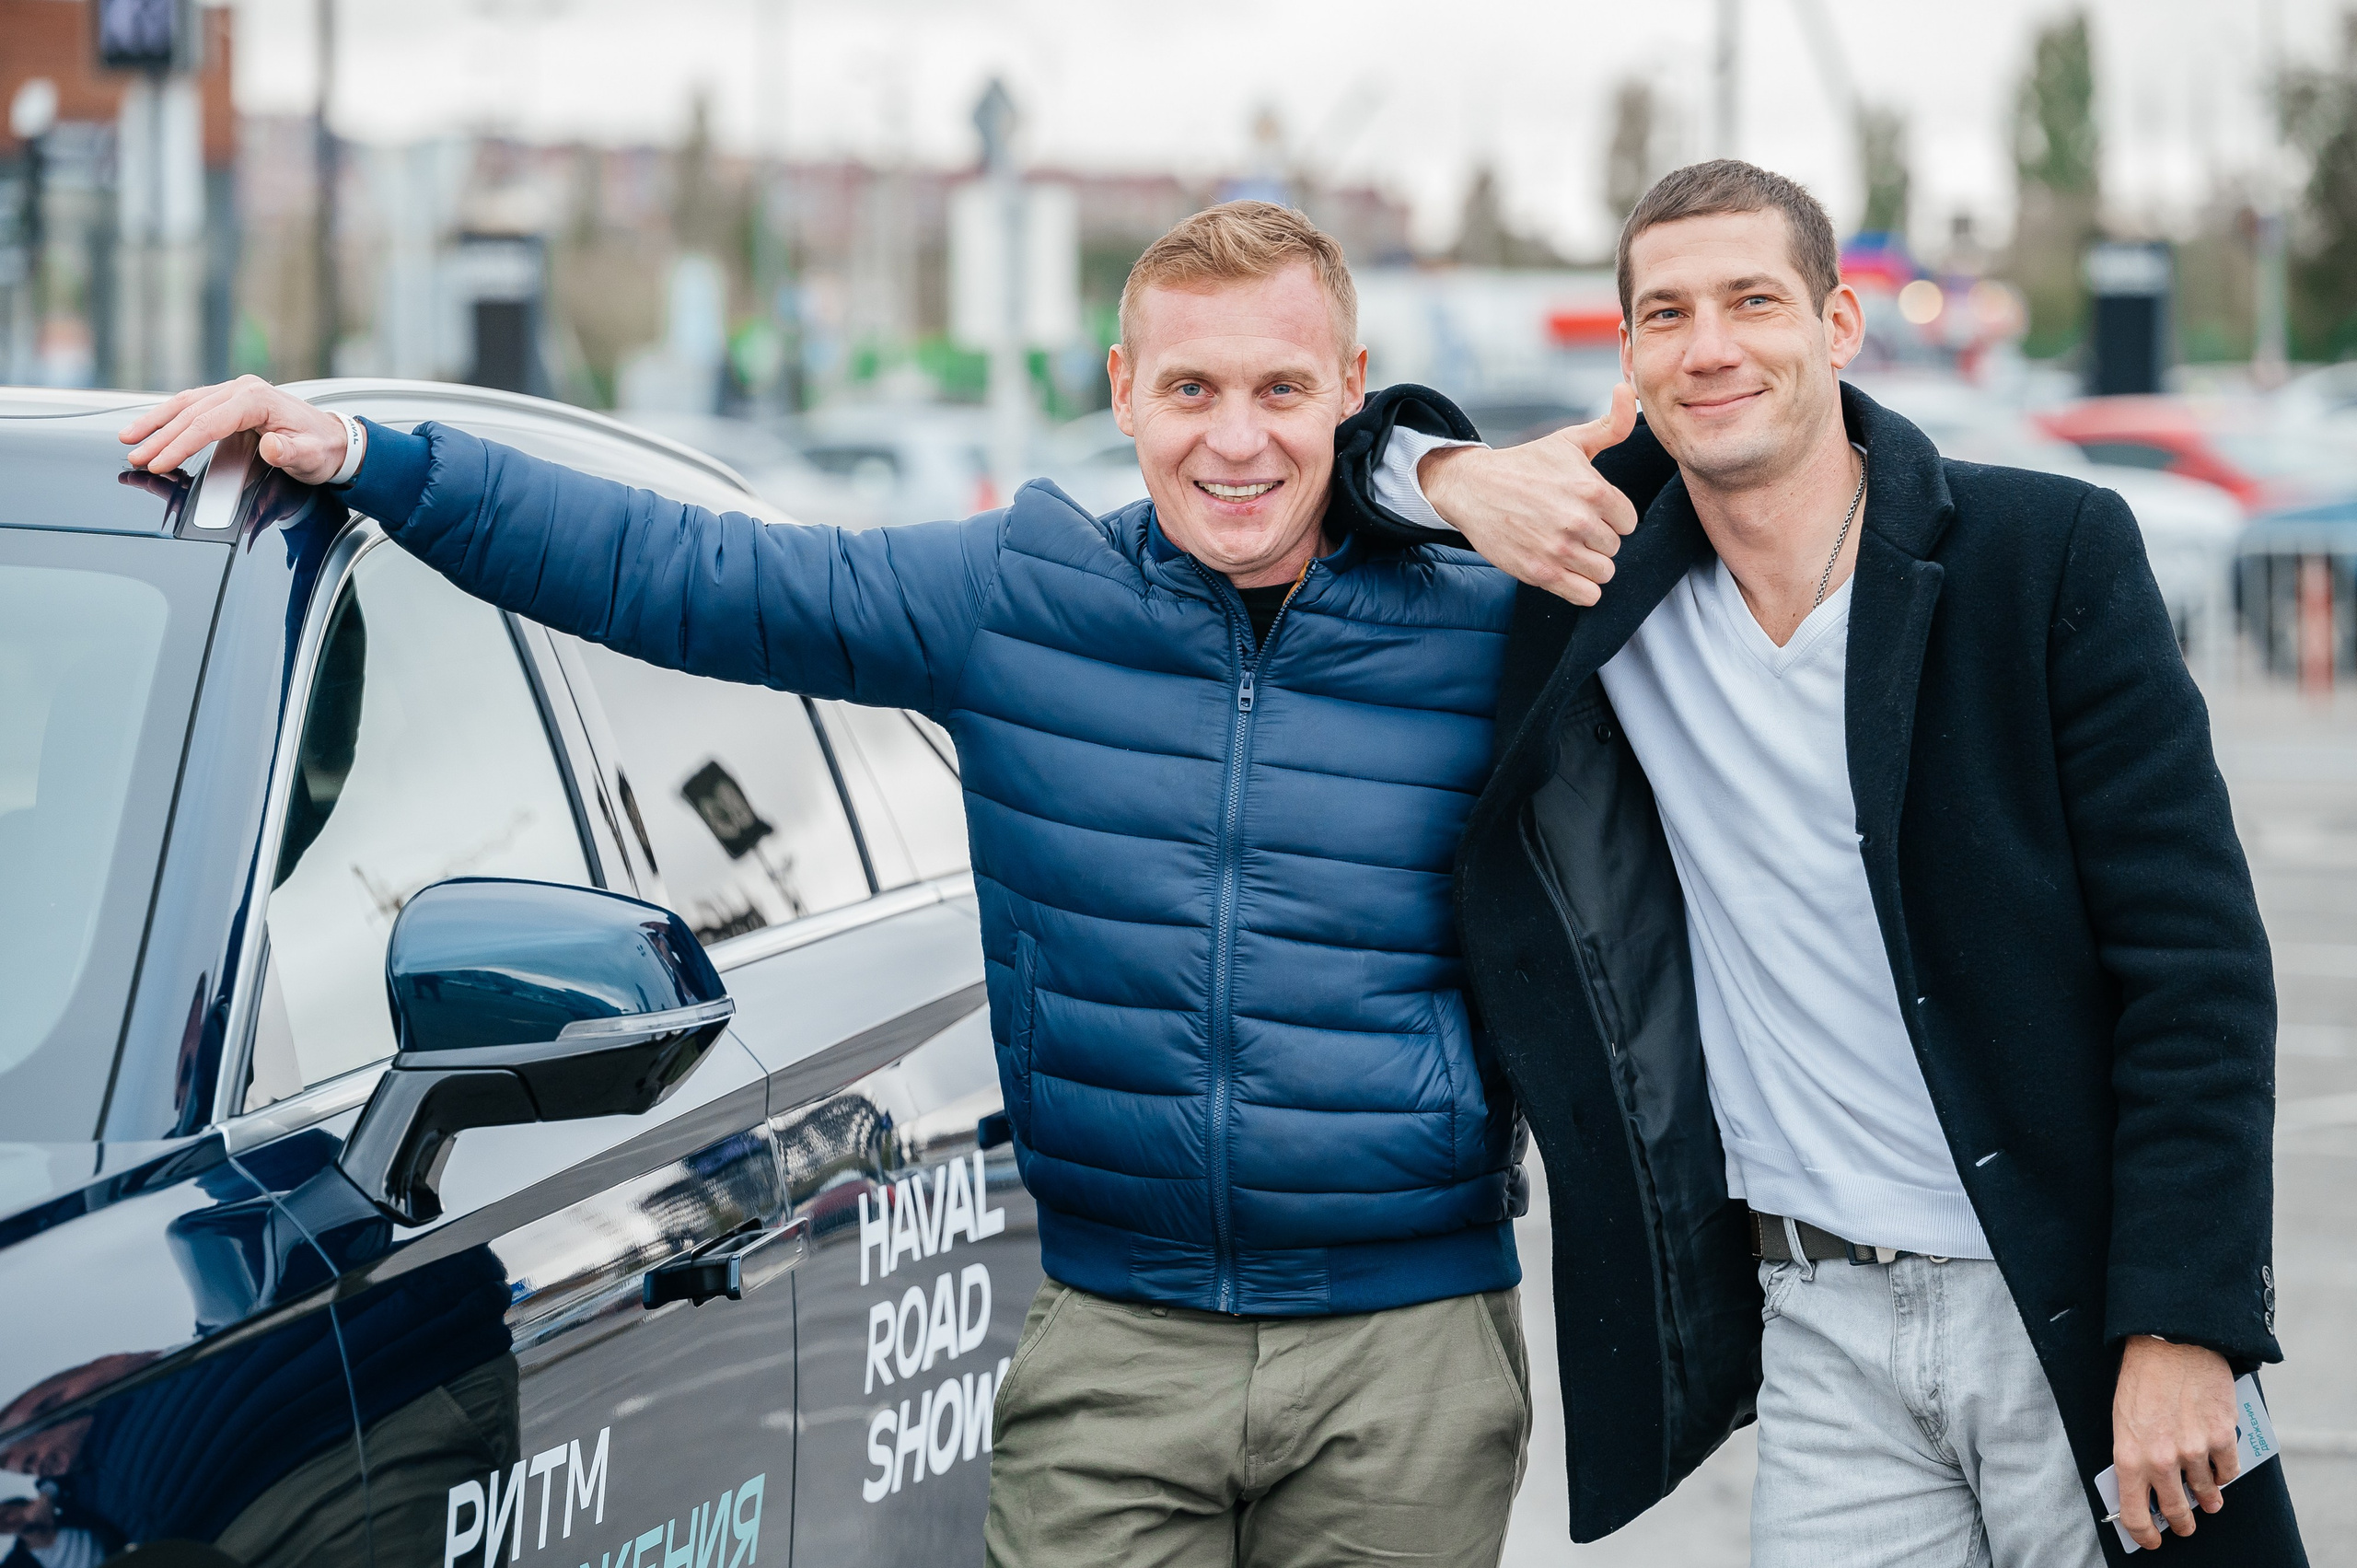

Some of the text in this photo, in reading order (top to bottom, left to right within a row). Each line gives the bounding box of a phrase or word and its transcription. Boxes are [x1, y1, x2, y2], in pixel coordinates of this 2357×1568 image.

[858, 1149, 1005, 1286] HAVAL
[864, 1263, 992, 1396] ROAD
[862, 1357, 1012, 1504] SHOW
[2243, 1401, 2271, 1452] ДВИЖЕНИЯ
[2247, 1432, 2262, 1458] РИТМ
[444, 1425, 610, 1568] РИТМ
